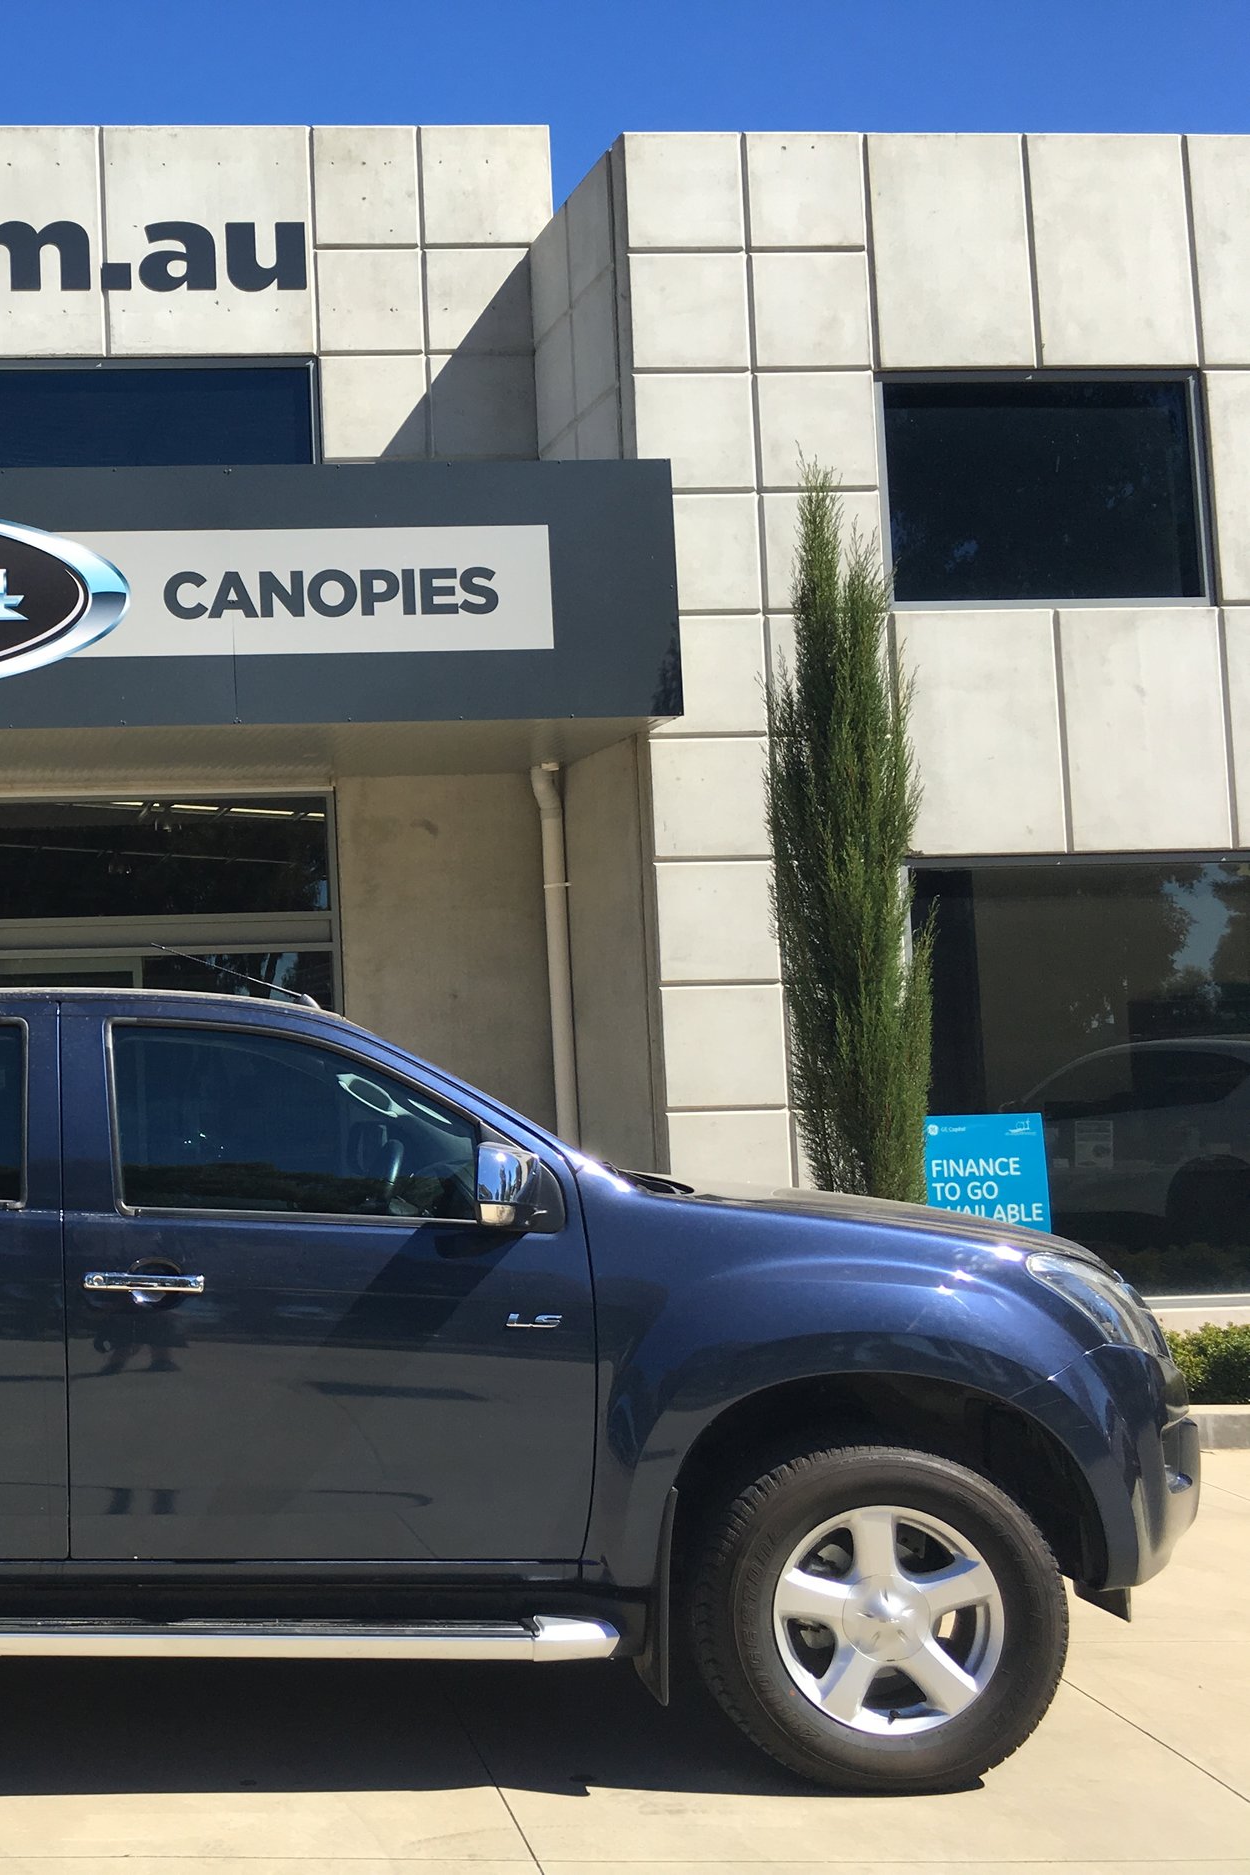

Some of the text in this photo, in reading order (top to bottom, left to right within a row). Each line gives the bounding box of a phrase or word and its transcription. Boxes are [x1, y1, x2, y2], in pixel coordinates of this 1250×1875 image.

[163, 566, 499, 620] CANOPIES
[931, 1157, 1021, 1178] FINANCE
[932, 1181, 999, 1201] TO GO
[944, 1203, 1044, 1223] AILABLE
[506, 1313, 562, 1328] LS
